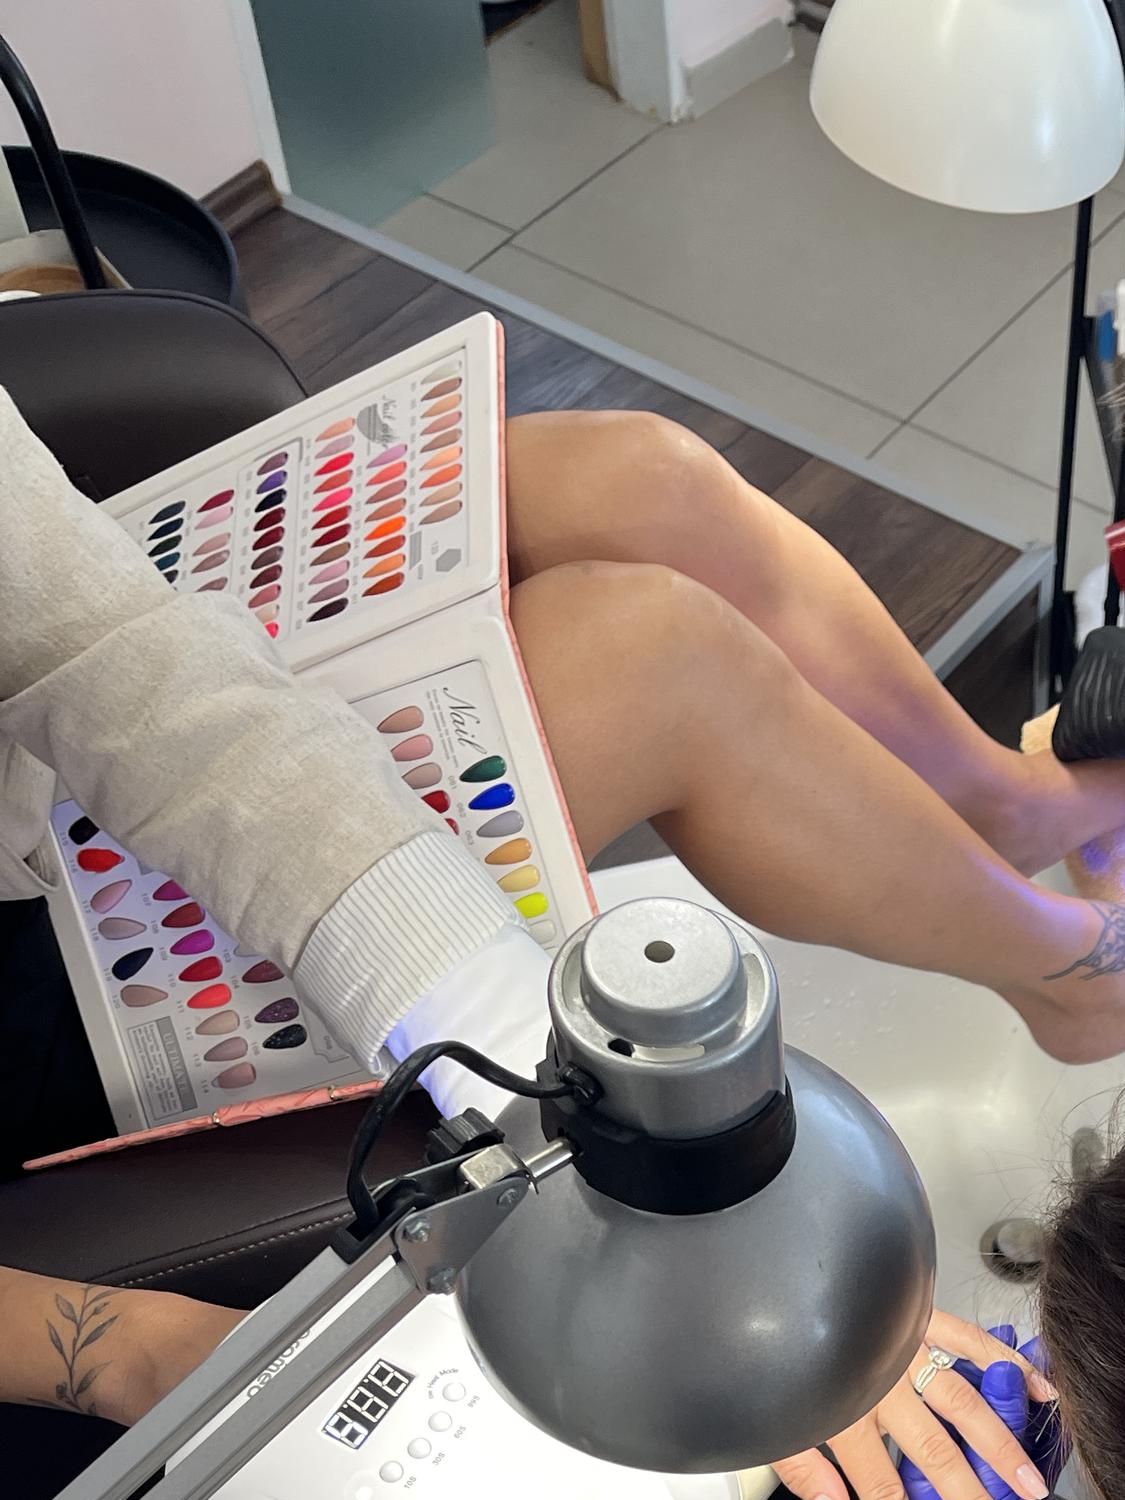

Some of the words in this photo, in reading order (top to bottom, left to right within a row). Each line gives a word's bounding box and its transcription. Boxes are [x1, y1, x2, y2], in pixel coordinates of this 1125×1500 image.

[442, 687, 488, 755] Nail
[438, 1367, 459, 1377] Mode
[432, 1452, 446, 1466] 30S
[403, 1475, 417, 1490] 10S
